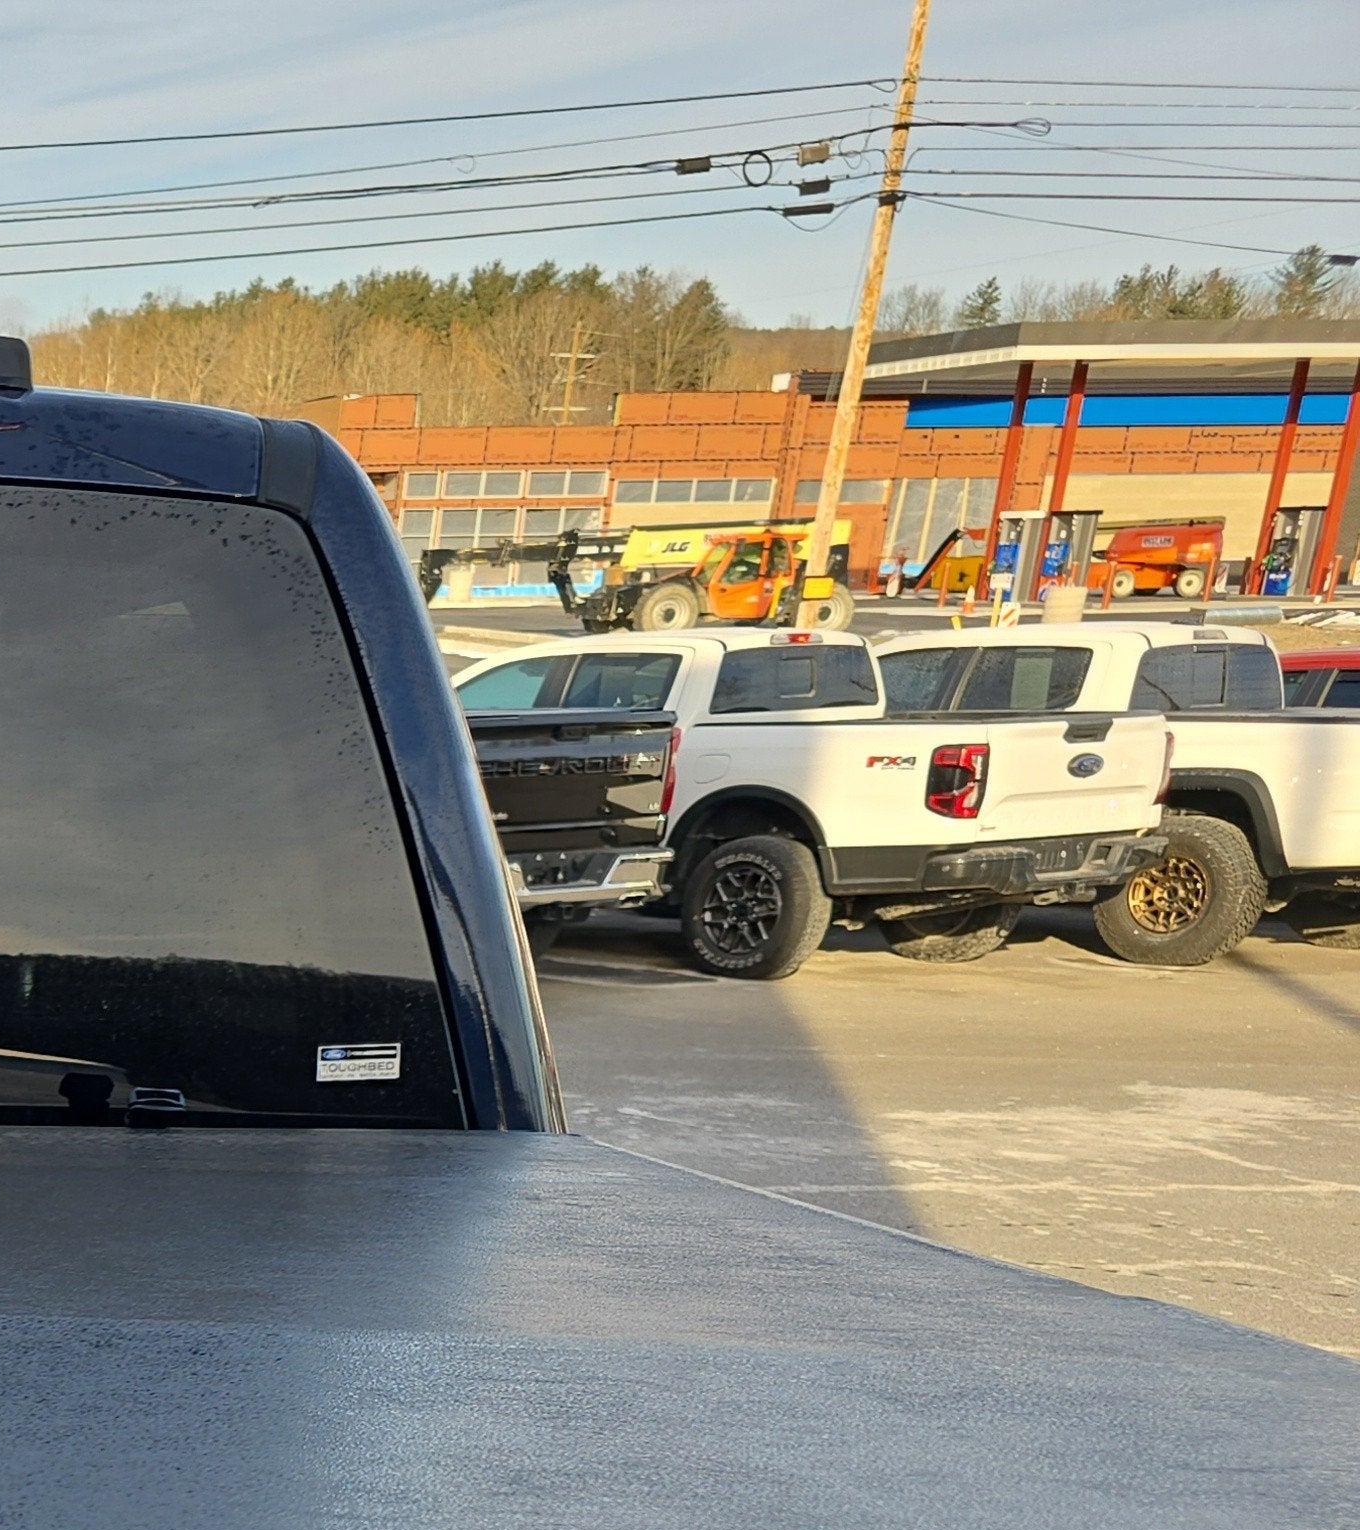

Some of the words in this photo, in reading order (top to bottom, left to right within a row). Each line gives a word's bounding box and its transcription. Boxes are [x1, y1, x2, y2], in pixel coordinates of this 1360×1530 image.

[661, 541, 690, 553] JLG
[865, 755, 917, 768] FX4
[321, 1061, 395, 1072] TOUGHBED
